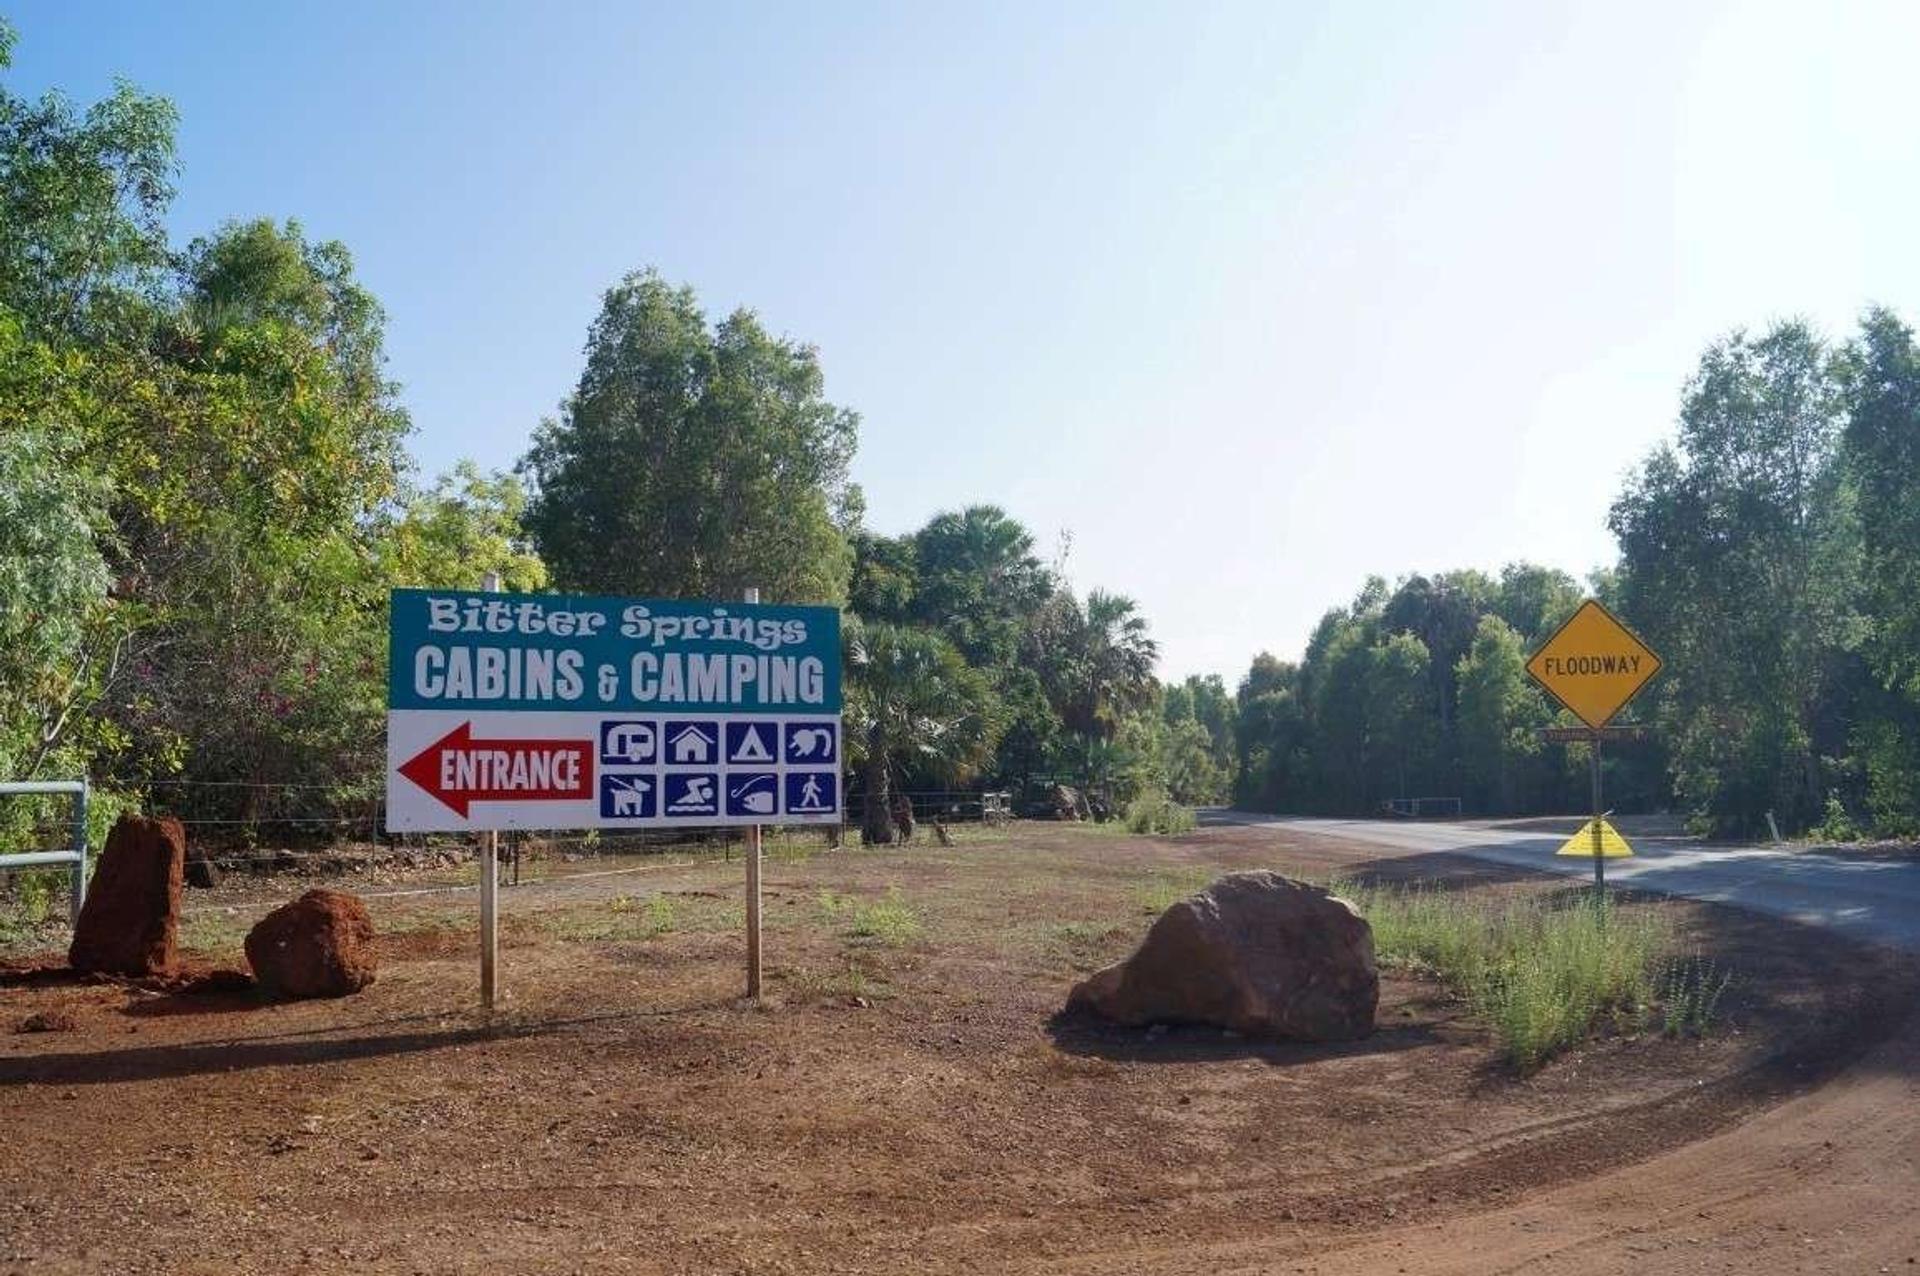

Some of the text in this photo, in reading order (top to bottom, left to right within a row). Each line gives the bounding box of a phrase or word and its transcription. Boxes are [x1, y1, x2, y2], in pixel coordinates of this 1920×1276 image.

[428, 597, 807, 648] Bitter Springs
[414, 645, 824, 704] CABINS & CAMPING
[1545, 655, 1640, 676] FLOODWAY
[440, 749, 580, 791] ENTRANCE
